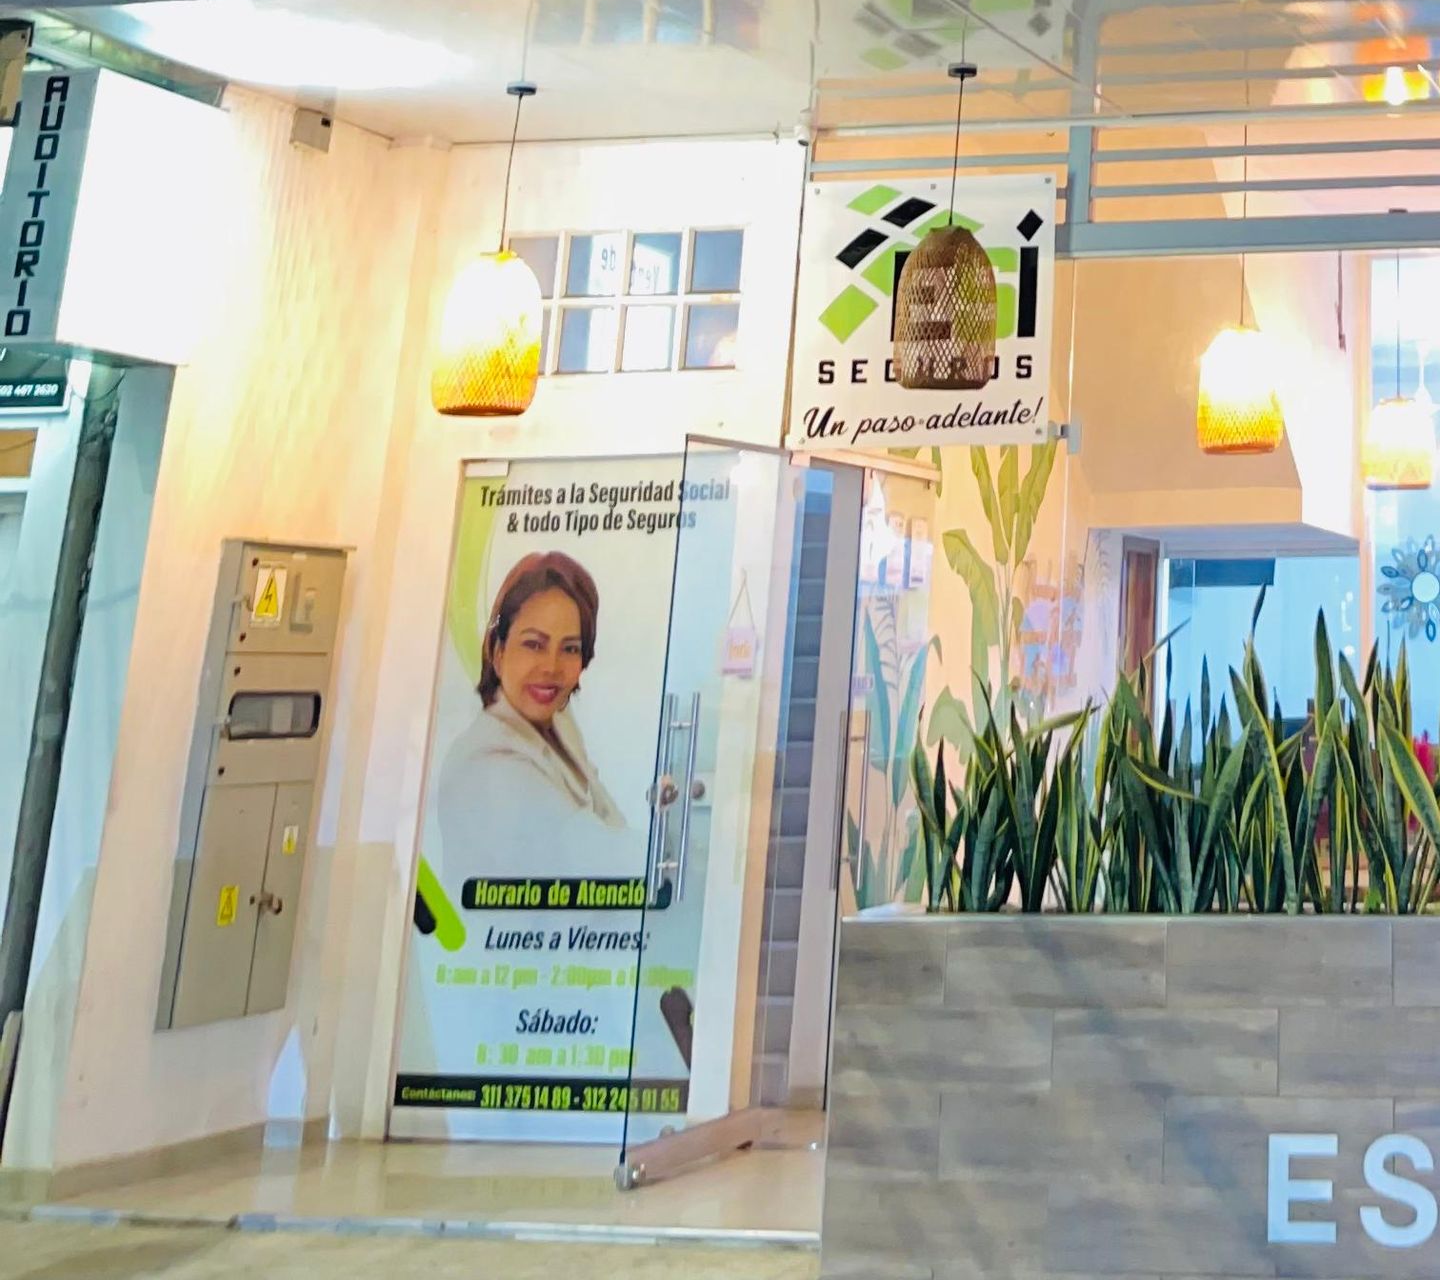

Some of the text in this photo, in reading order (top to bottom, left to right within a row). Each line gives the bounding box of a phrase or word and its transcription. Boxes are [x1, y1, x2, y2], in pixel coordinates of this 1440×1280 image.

[5, 76, 69, 336] AUDITORIO
[803, 396, 1044, 445] Un paso adelante!
[480, 478, 730, 508] Trámites a la Seguridad Social
[507, 508, 696, 536] & todo Tipo de Seguros
[474, 879, 652, 907] Horario de Atenció
[485, 926, 650, 951] Lunes a Viernes:
[515, 1008, 599, 1035] Sábado:
[480, 1085, 502, 1109] 311
[534, 1086, 549, 1109] 14
[583, 1086, 607, 1111] 312
